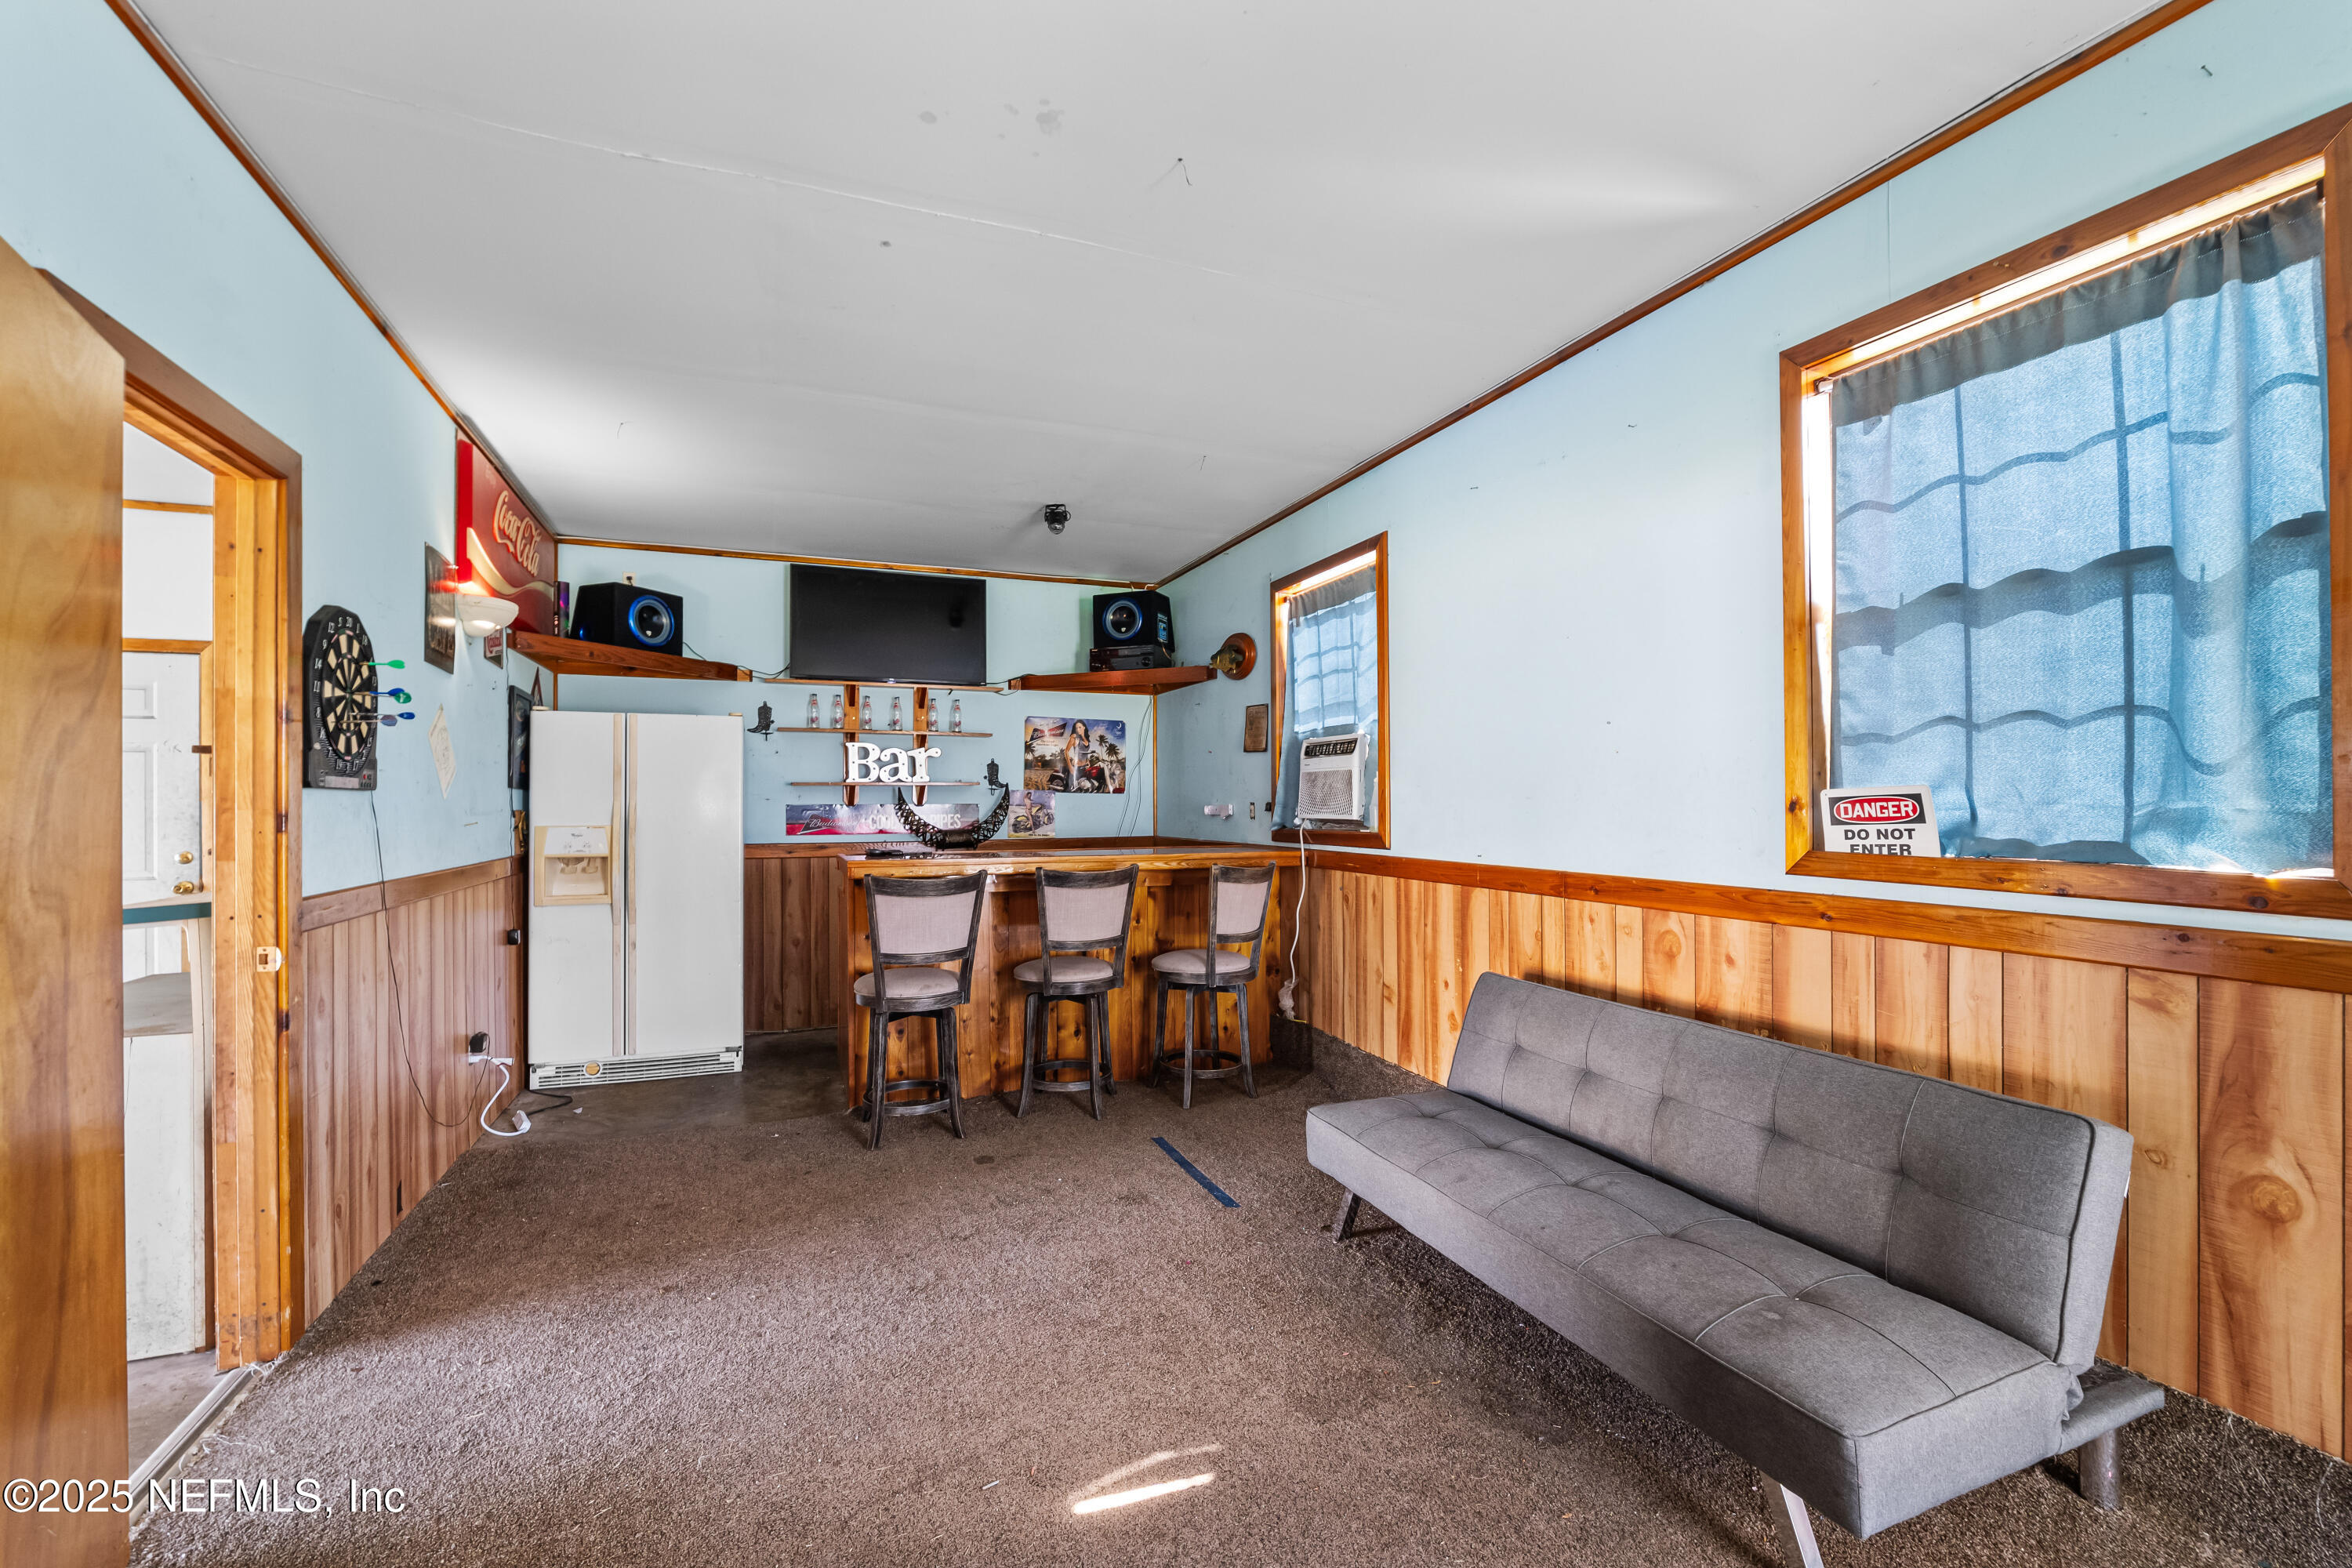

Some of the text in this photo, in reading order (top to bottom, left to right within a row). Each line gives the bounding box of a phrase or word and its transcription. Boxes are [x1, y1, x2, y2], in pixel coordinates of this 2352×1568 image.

[328, 622, 335, 633] 12
[338, 617, 343, 627] 5
[346, 616, 353, 627] 20
[322, 639, 328, 650] 9
[314, 658, 322, 670] 14
[314, 680, 321, 692] 11
[316, 706, 321, 718] 8
[845, 742, 942, 782] Bar
[1839, 800, 1915, 818] DANGER
[929, 813, 961, 829] PIPES
[1844, 828, 1915, 840] DO NOT
[1849, 844, 1912, 855] ENTER
